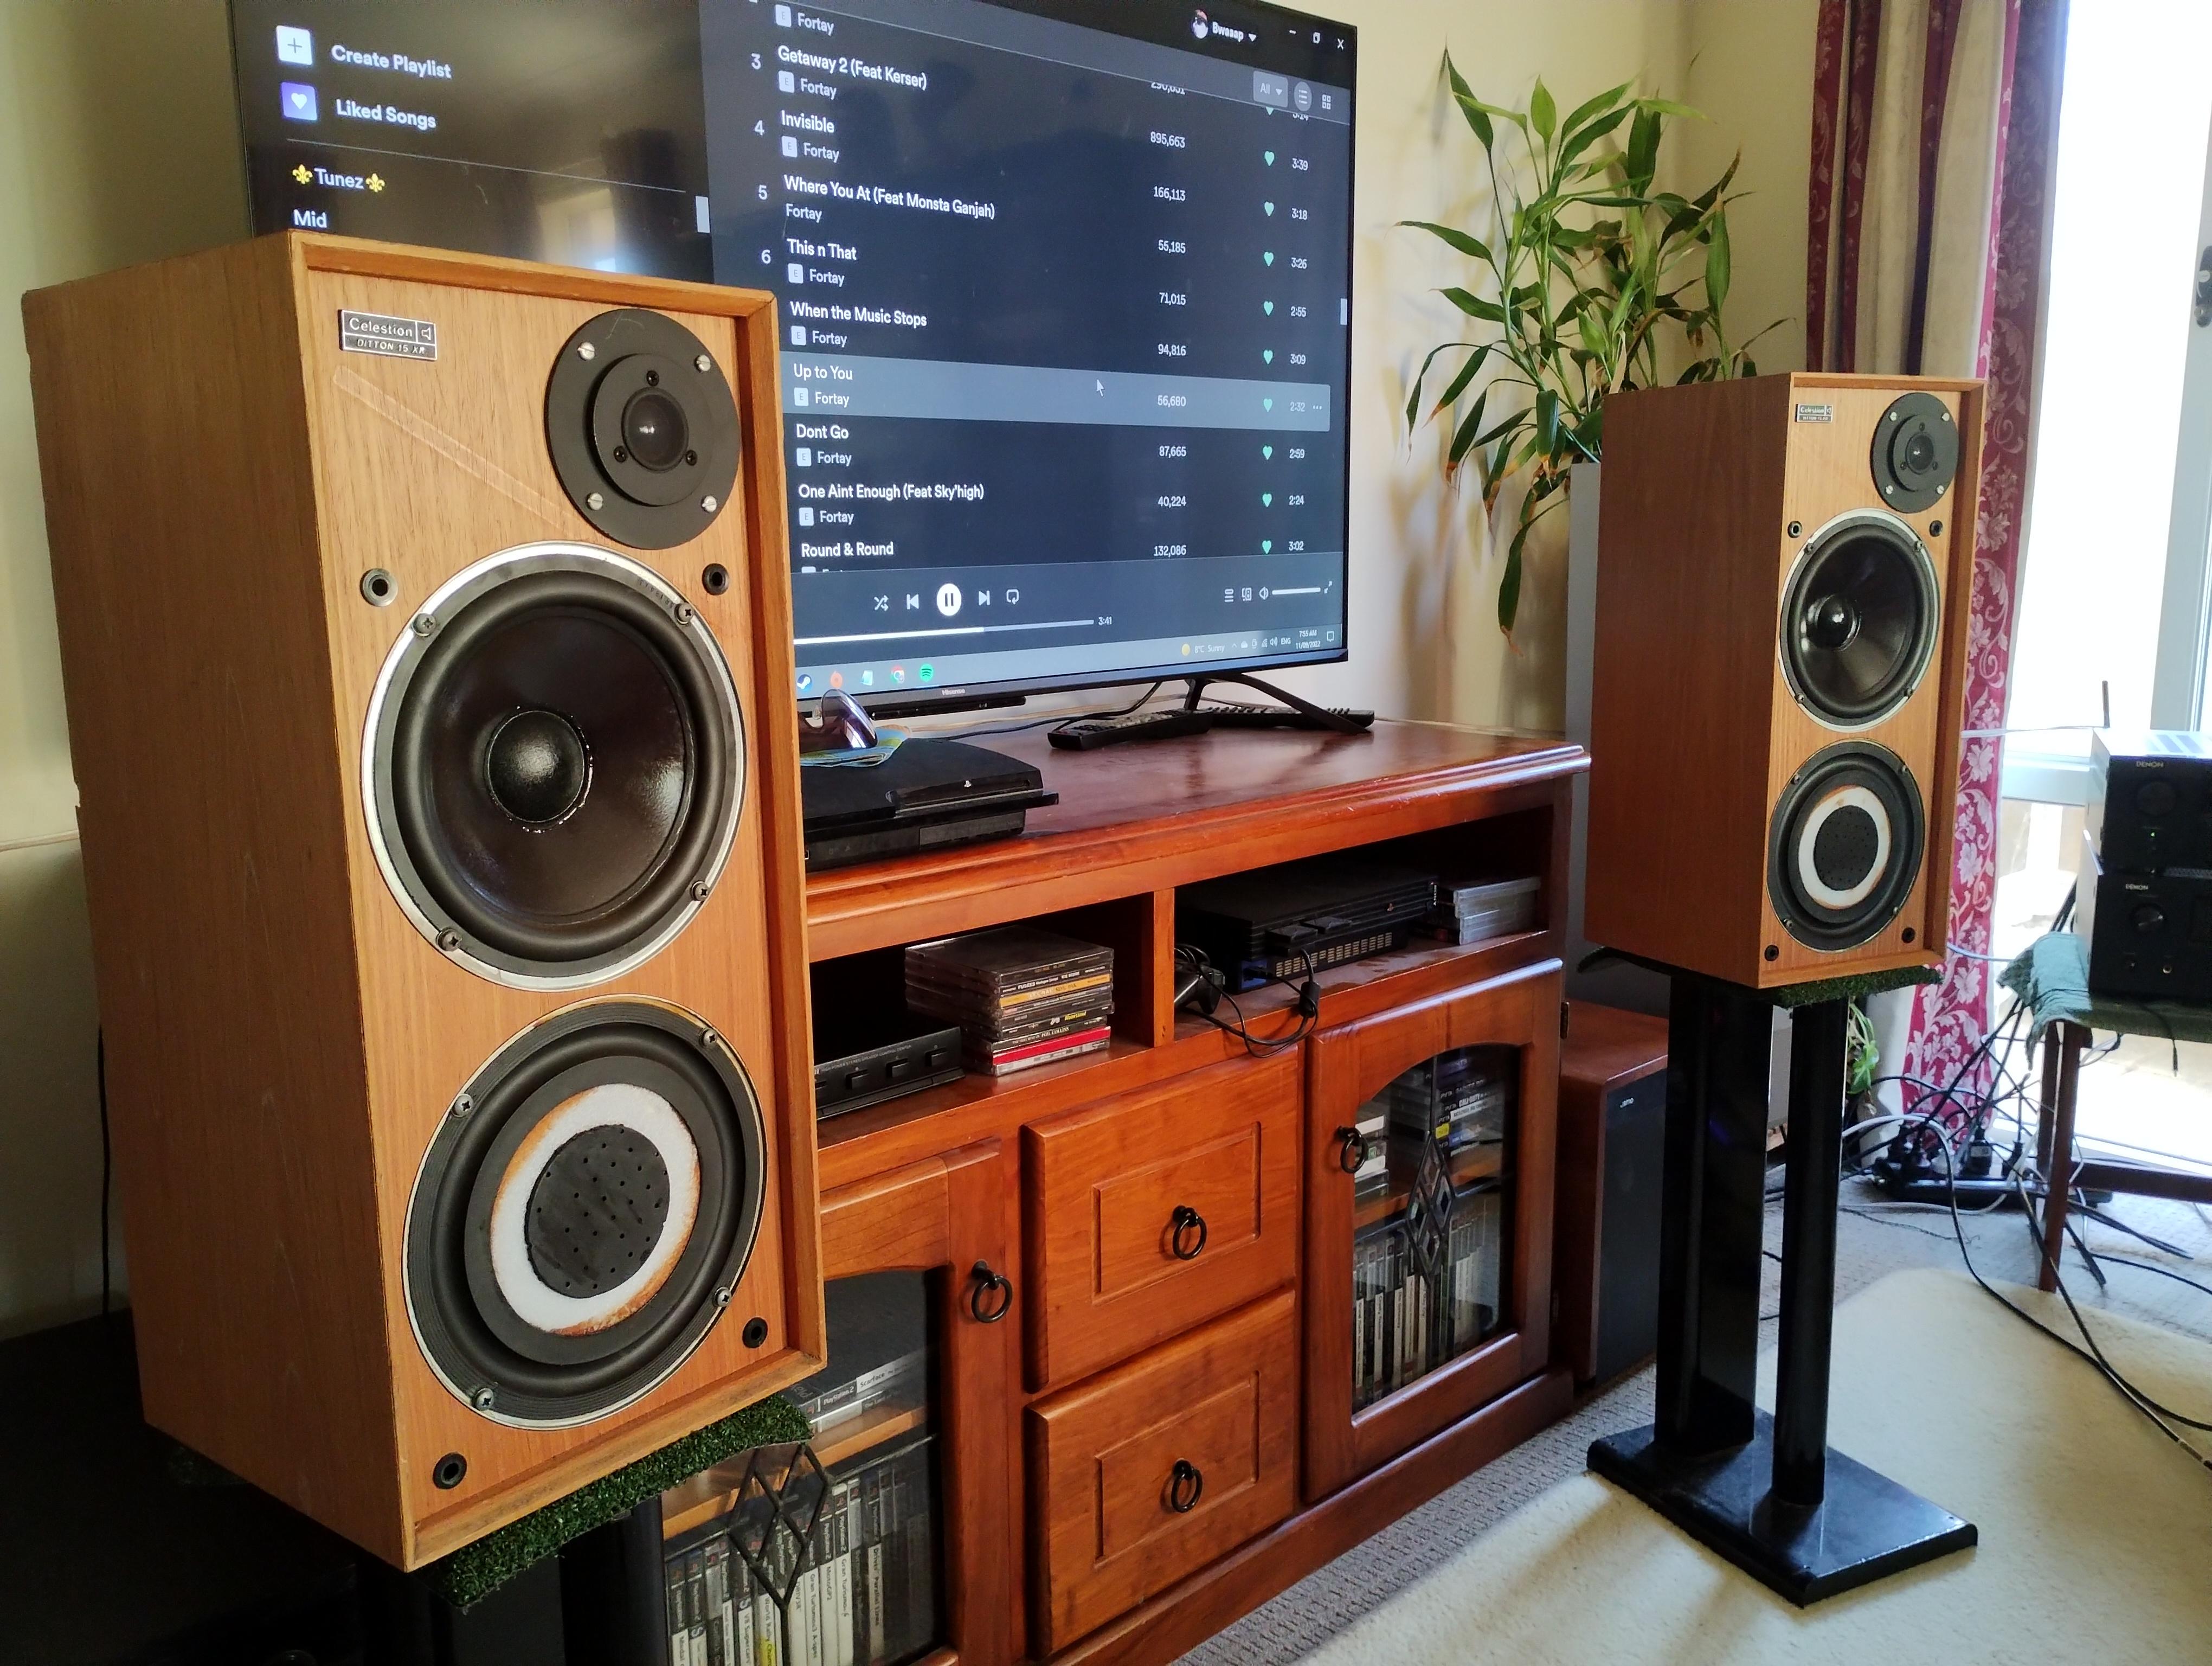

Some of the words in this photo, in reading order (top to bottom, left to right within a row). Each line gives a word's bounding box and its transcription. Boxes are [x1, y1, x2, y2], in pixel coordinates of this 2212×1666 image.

[798, 12, 834, 36] Fortay
[1212, 22, 1244, 42] Bwaaap
[332, 45, 390, 68] Create
[393, 54, 451, 78] Playlist
[751, 54, 761, 69] 3
[778, 46, 837, 74] Getaway
[839, 57, 847, 73] 2
[850, 59, 882, 80] (Feat
[885, 66, 927, 91] Kerser)
[801, 78, 837, 100] Fortay
[1261, 83, 1270, 94] All
[337, 99, 382, 120] Liked
[385, 106, 436, 130] Songs
[781, 110, 834, 133] Invisible
[755, 120, 764, 136] 4
[1151, 131, 1185, 148] 895,663
[803, 143, 839, 163] Fortay
[1293, 158, 1308, 170] 3:39
[314, 168, 364, 189] Tunez
[758, 185, 767, 200] 5
[784, 175, 828, 195] Where
[830, 181, 853, 198] You
[857, 185, 871, 201] At
[873, 187, 903, 205] (Feat
[906, 193, 949, 212] Monsta
[953, 200, 994, 220] Ganjah)
[1154, 186, 1185, 201] 166,113
[294, 209, 327, 228] Mid
[786, 203, 822, 223] Fortay
[1292, 208, 1307, 220] 3:18
[787, 239, 815, 255] This
[818, 246, 825, 257] n
[828, 244, 857, 260] That
[1159, 240, 1185, 253] 55,185
[762, 249, 770, 264] 6
[1291, 258, 1307, 268] 3:26
[810, 269, 844, 287] Fortay
[1160, 292, 1186, 305] 71,015
[790, 301, 828, 318] When
[831, 305, 851, 320] the
[854, 307, 891, 323] Music
[893, 310, 927, 329] Stops
[1291, 306, 1306, 317] 2:55
[349, 317, 413, 337] Celestion
[357, 338, 394, 350] DITTON
[398, 344, 408, 353] 15
[813, 330, 847, 348] Fortay
[1159, 344, 1186, 356] 94,816
[1290, 354, 1306, 364] 3:09
[794, 363, 811, 381] Up
[814, 366, 827, 378] to
[830, 366, 852, 380] You
[815, 392, 849, 408] Fortay
[1158, 395, 1186, 407] 56,680
[1290, 402, 1305, 412] 2:32
[796, 424, 827, 438] Dont
[830, 425, 848, 439] Go
[818, 451, 851, 466] Fortay
[1160, 446, 1186, 458] 87,665
[1290, 448, 1304, 458] 2:59
[799, 484, 825, 498] One
[828, 484, 853, 498] Aint
[857, 484, 900, 501] Enough
[903, 483, 932, 500] (Feat
[935, 484, 983, 501] Sky'high)
[1158, 496, 1186, 508] 40,224
[1289, 495, 1304, 505] 2:24
[820, 510, 854, 525] Fortay
[802, 543, 840, 557] Round
[844, 543, 854, 555] &
[857, 541, 893, 555] Round
[1154, 545, 1186, 557] 132,086
[1289, 541, 1303, 550] 3:02
[1098, 617, 1111, 625] 3:41
[1207, 644, 1225, 653] Sunny
[859, 1373, 885, 1388] Scarface
